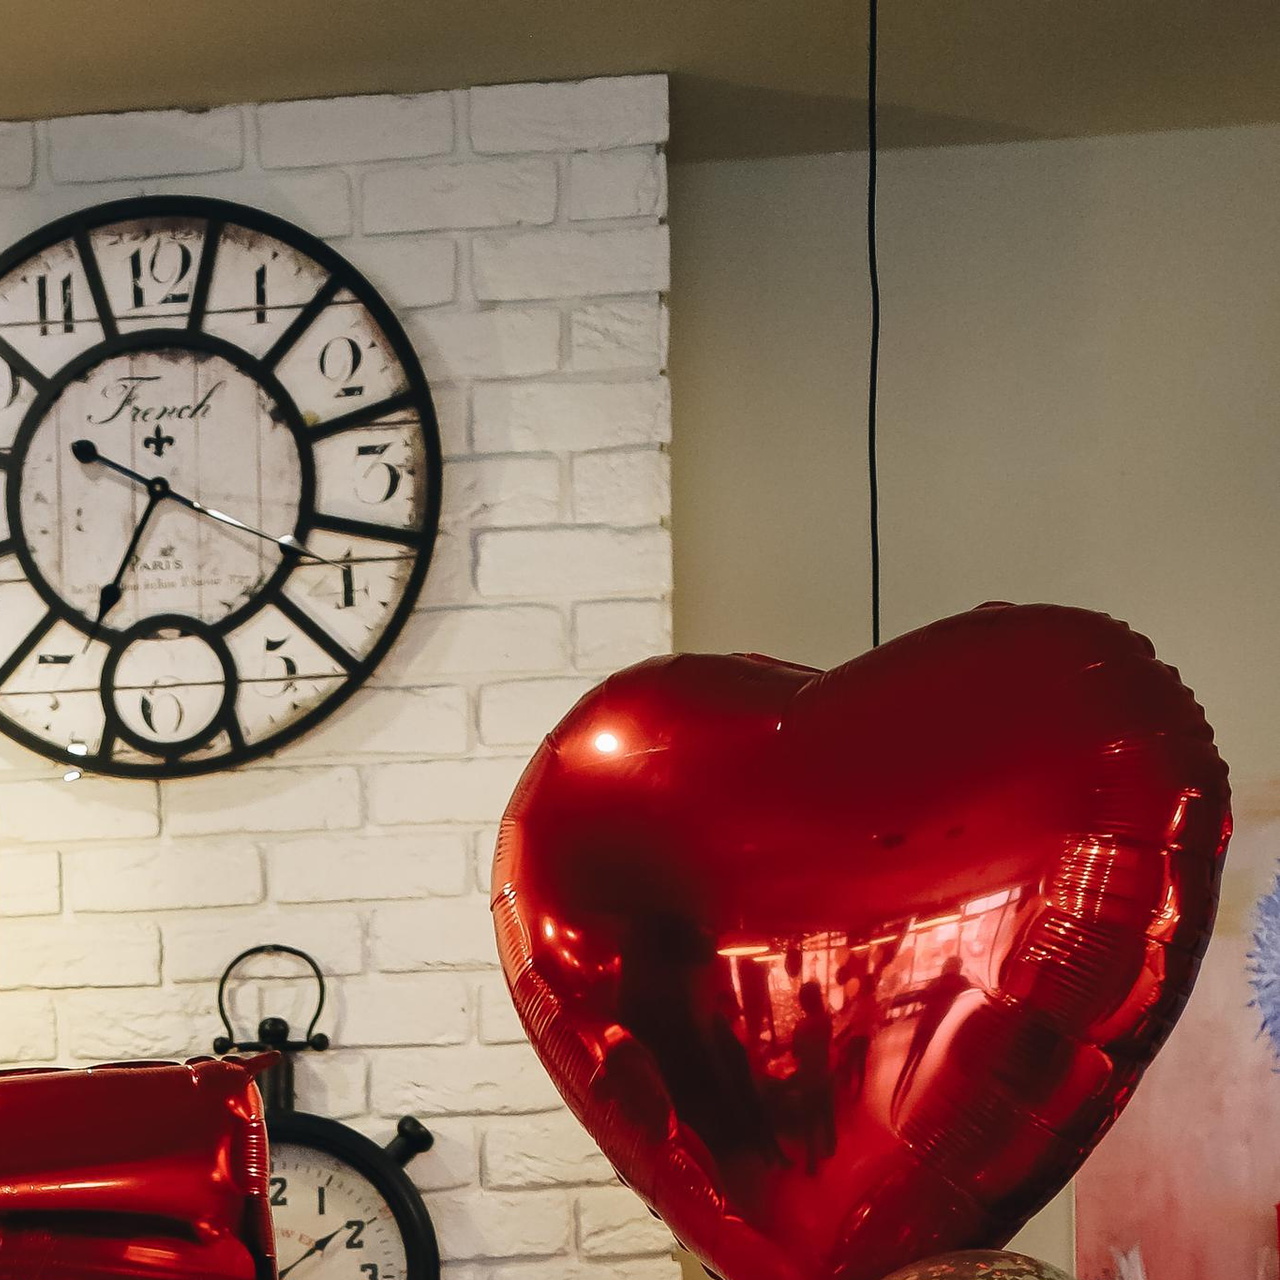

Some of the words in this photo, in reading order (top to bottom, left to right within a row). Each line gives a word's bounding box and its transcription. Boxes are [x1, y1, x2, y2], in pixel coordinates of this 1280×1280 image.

[129, 237, 193, 309] 12
[253, 263, 270, 324] 1
[36, 272, 75, 336] 11
[319, 336, 364, 398] 2
[86, 375, 226, 425] French
[354, 441, 401, 504] 3
[140, 674, 185, 735] 6
[270, 1177, 287, 1206] 2
[318, 1186, 325, 1215] 1
[345, 1220, 365, 1249] 2
